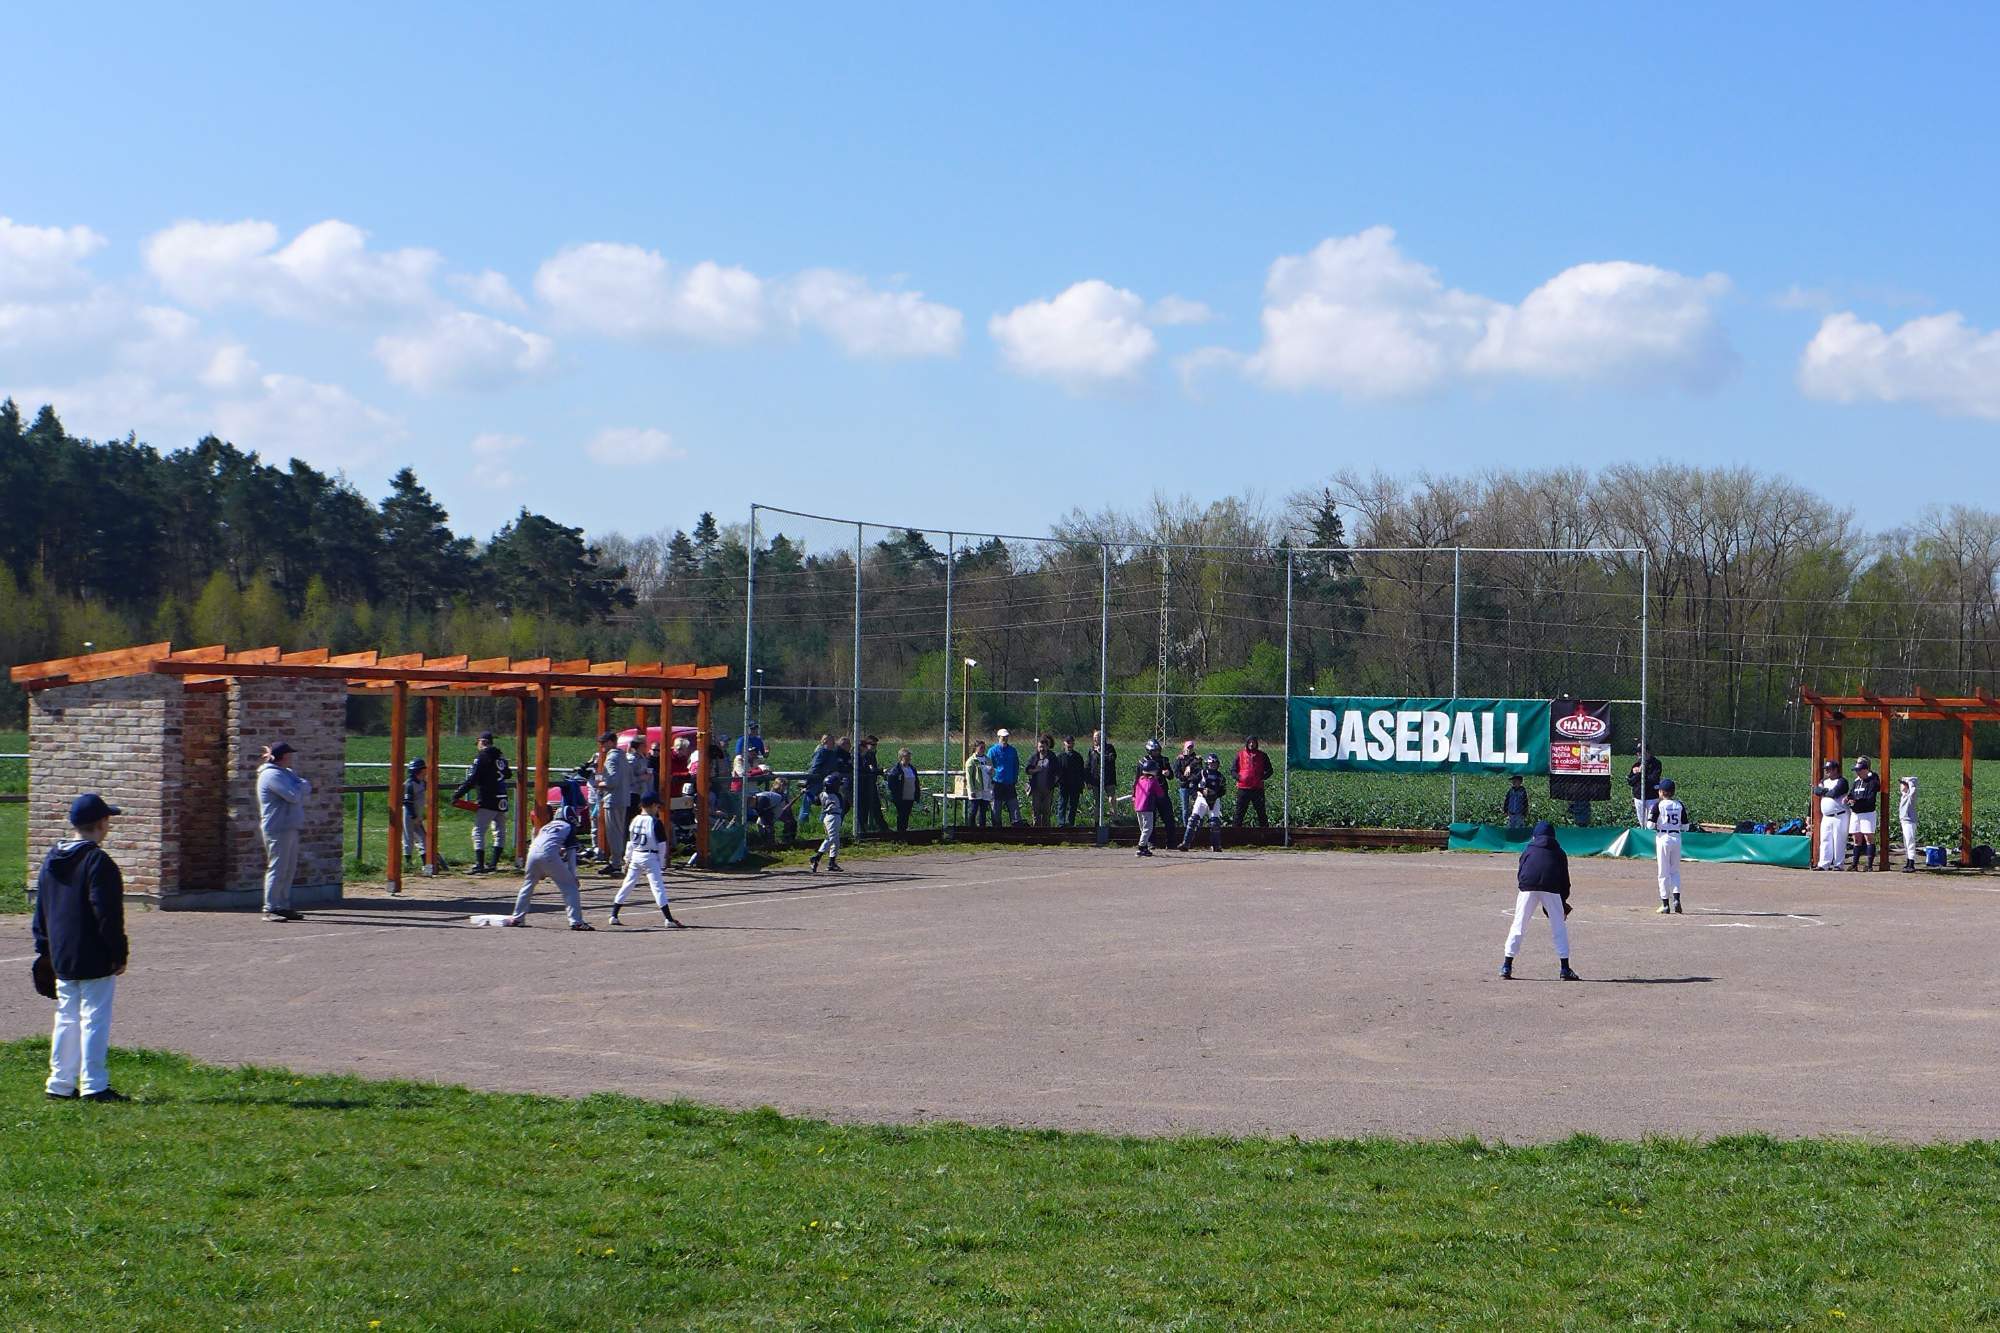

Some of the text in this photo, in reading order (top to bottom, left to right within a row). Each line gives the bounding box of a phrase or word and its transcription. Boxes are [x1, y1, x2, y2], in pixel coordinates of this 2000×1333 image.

[1563, 717, 1599, 730] HAINZ
[1310, 709, 1529, 764] BASEBALL
[1667, 813, 1679, 825] 15
